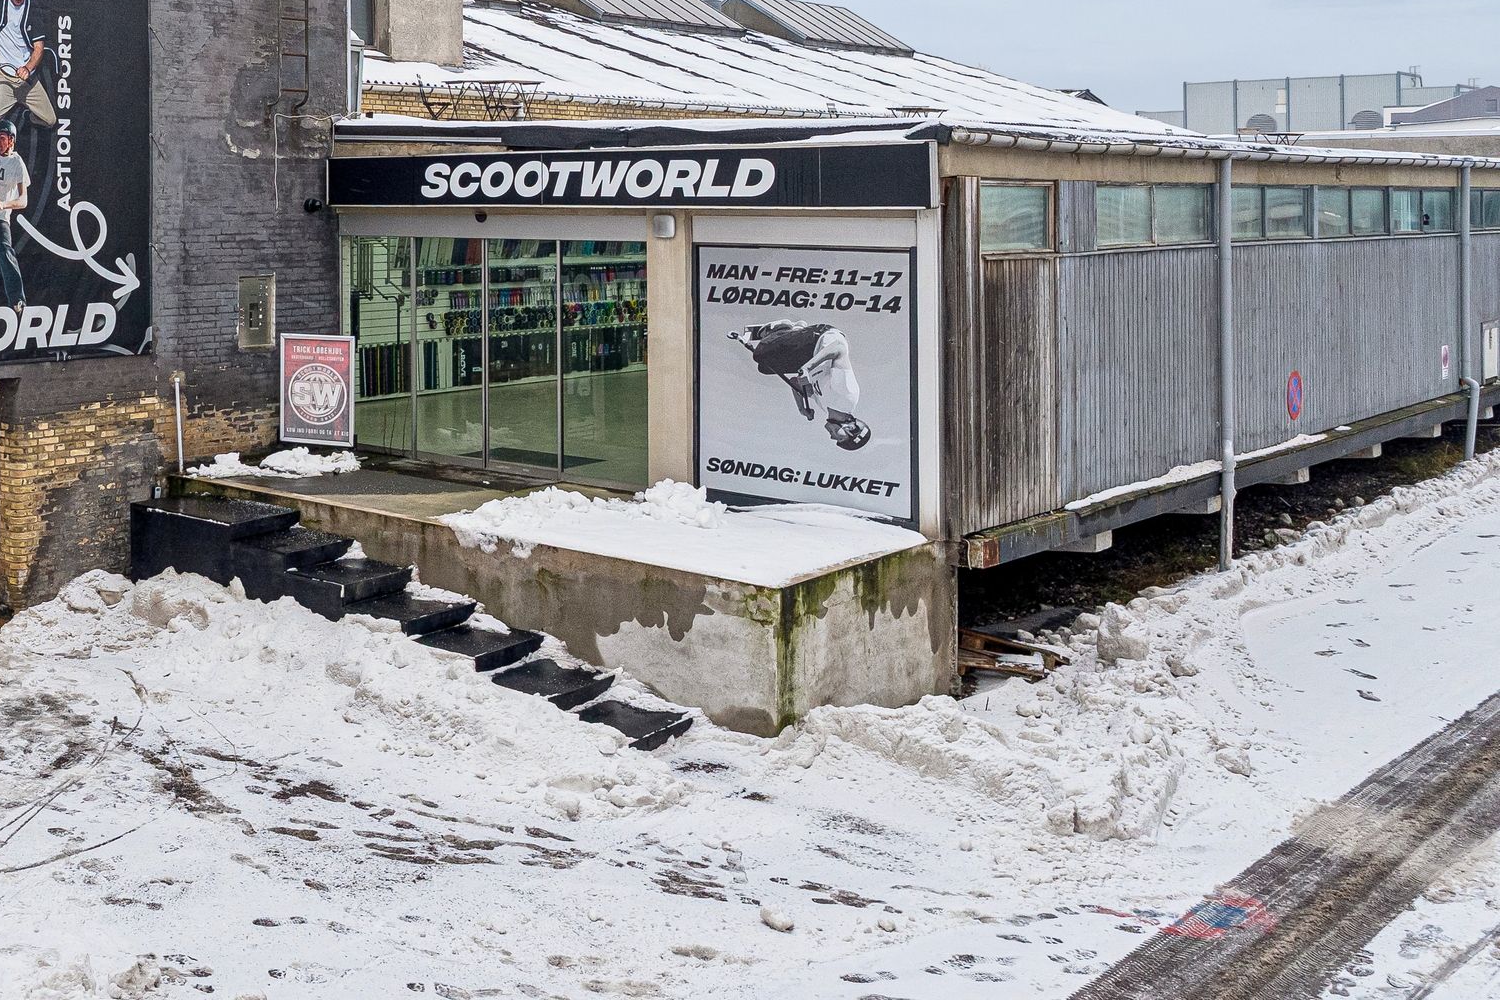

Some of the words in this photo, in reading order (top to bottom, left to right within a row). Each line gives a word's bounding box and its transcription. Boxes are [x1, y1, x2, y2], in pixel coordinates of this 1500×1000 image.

[57, 15, 72, 110] SPORTS
[57, 118, 71, 212] ACTION
[420, 158, 776, 199] SCOOTWORLD
[706, 263, 759, 281] MAN
[775, 266, 829, 284] FRE:
[830, 269, 903, 288] 11-17
[706, 286, 818, 309] LØRDAG:
[820, 292, 903, 314] 10-14
[293, 345, 311, 354] TRICK
[292, 379, 343, 409] SW
[706, 457, 801, 483] SØNDAG:
[802, 471, 900, 498] LUKKET
